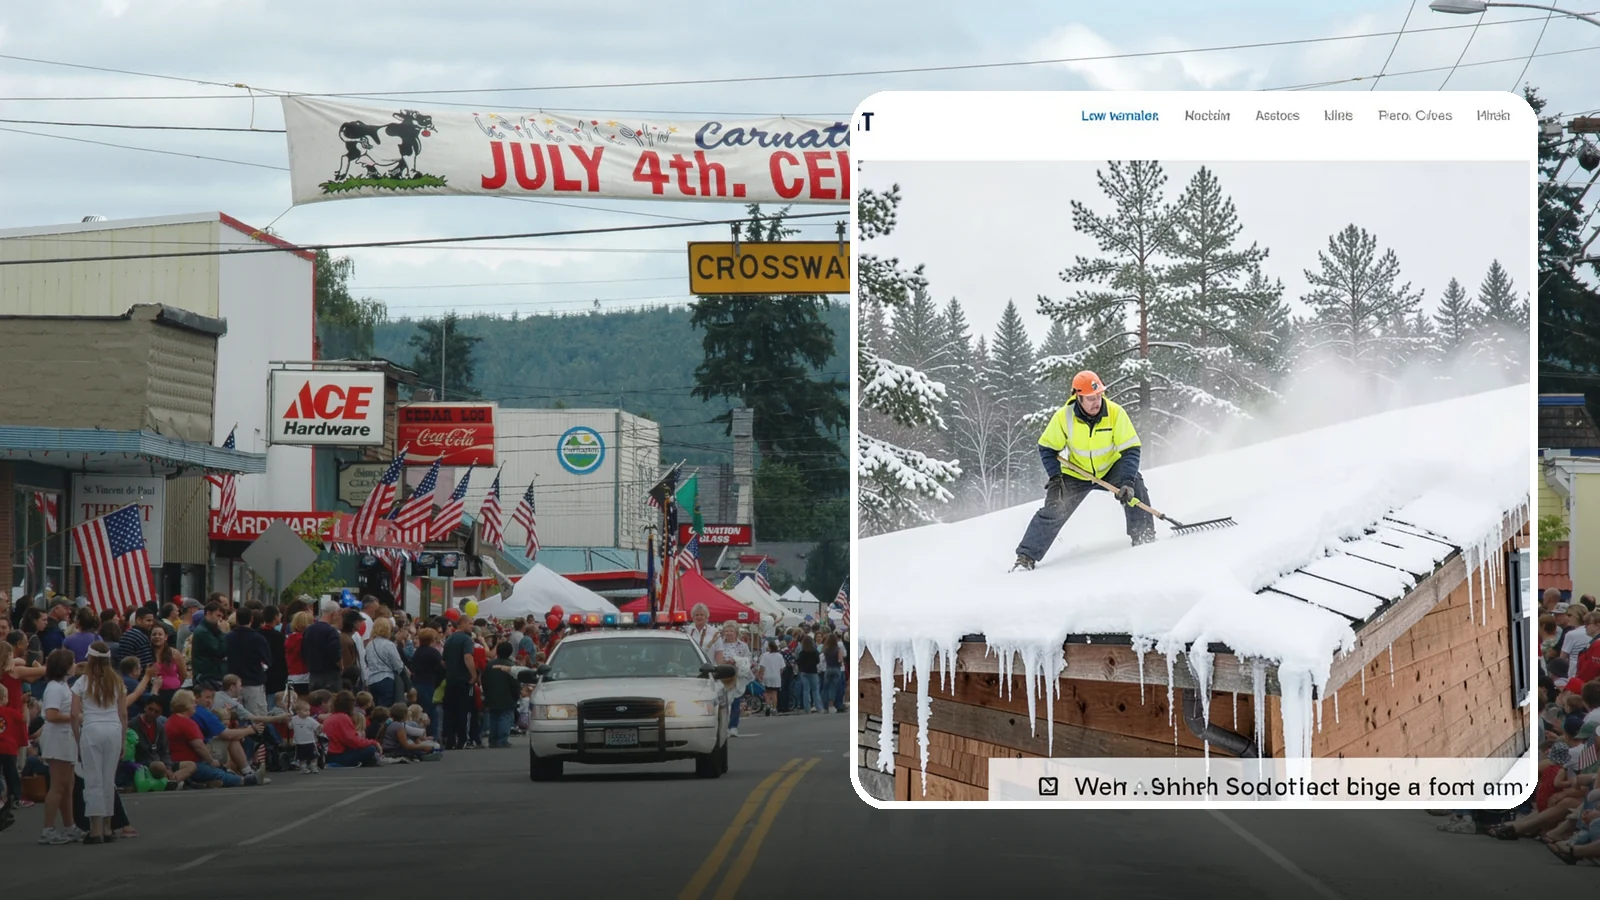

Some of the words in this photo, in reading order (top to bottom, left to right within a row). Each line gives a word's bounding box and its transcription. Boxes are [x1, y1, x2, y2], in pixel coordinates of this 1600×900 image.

[481, 141, 605, 193] JULY
[632, 150, 746, 198] 4th.
[697, 254, 850, 282] CROSSWA
[283, 380, 373, 420] ACE
[405, 409, 452, 422] CEDAR
[283, 421, 371, 437] Hardware
[416, 428, 477, 447] Coca-Cola
[96, 485, 124, 494] Vincent
[126, 486, 136, 494] de
[138, 486, 155, 495] Paul
[688, 526, 741, 535] CRNATION
[699, 535, 730, 543] GLASS
